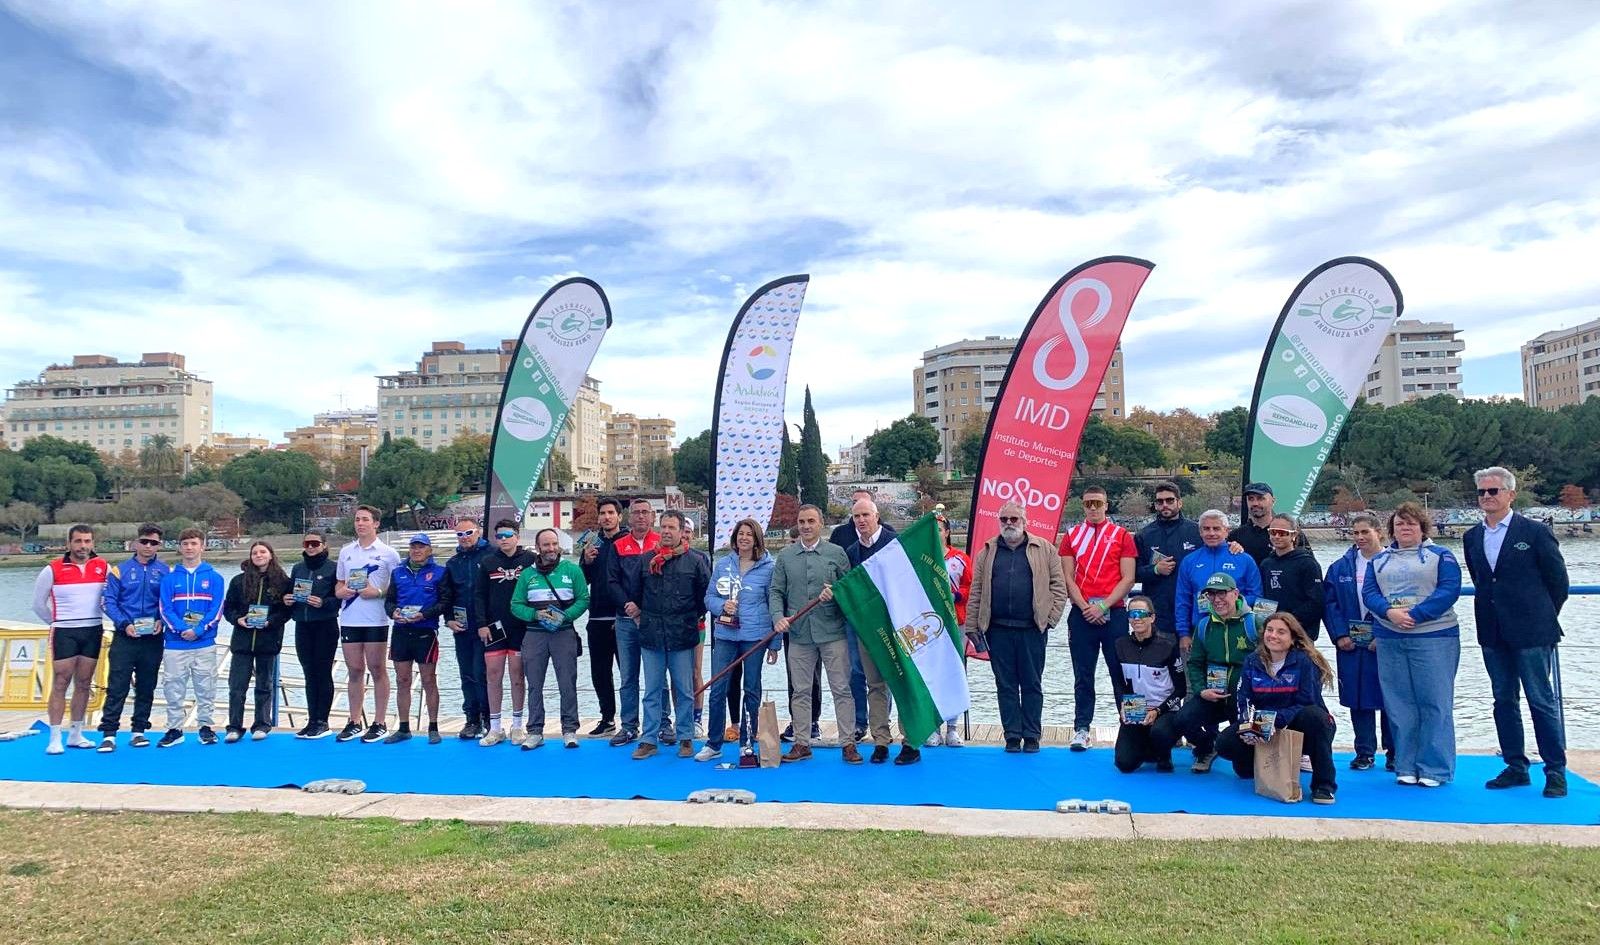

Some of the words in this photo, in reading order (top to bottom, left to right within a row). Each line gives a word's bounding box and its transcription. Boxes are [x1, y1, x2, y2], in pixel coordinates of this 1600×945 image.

[1313, 320, 1350, 337] ANDALUZA
[1354, 323, 1374, 336] REMO
[1014, 396, 1070, 431] IMD
[1272, 412, 1319, 430] REMOANDALUZ
[994, 431, 1030, 448] Instituto
[1032, 441, 1075, 459] Municipal
[1317, 447, 1329, 462] DE
[1324, 414, 1344, 445] REMO
[522, 457, 547, 506] ANDALUZA
[544, 442, 553, 454] DE
[550, 413, 566, 439] REMO
[1004, 447, 1016, 457] de
[1018, 450, 1058, 468] Deportes
